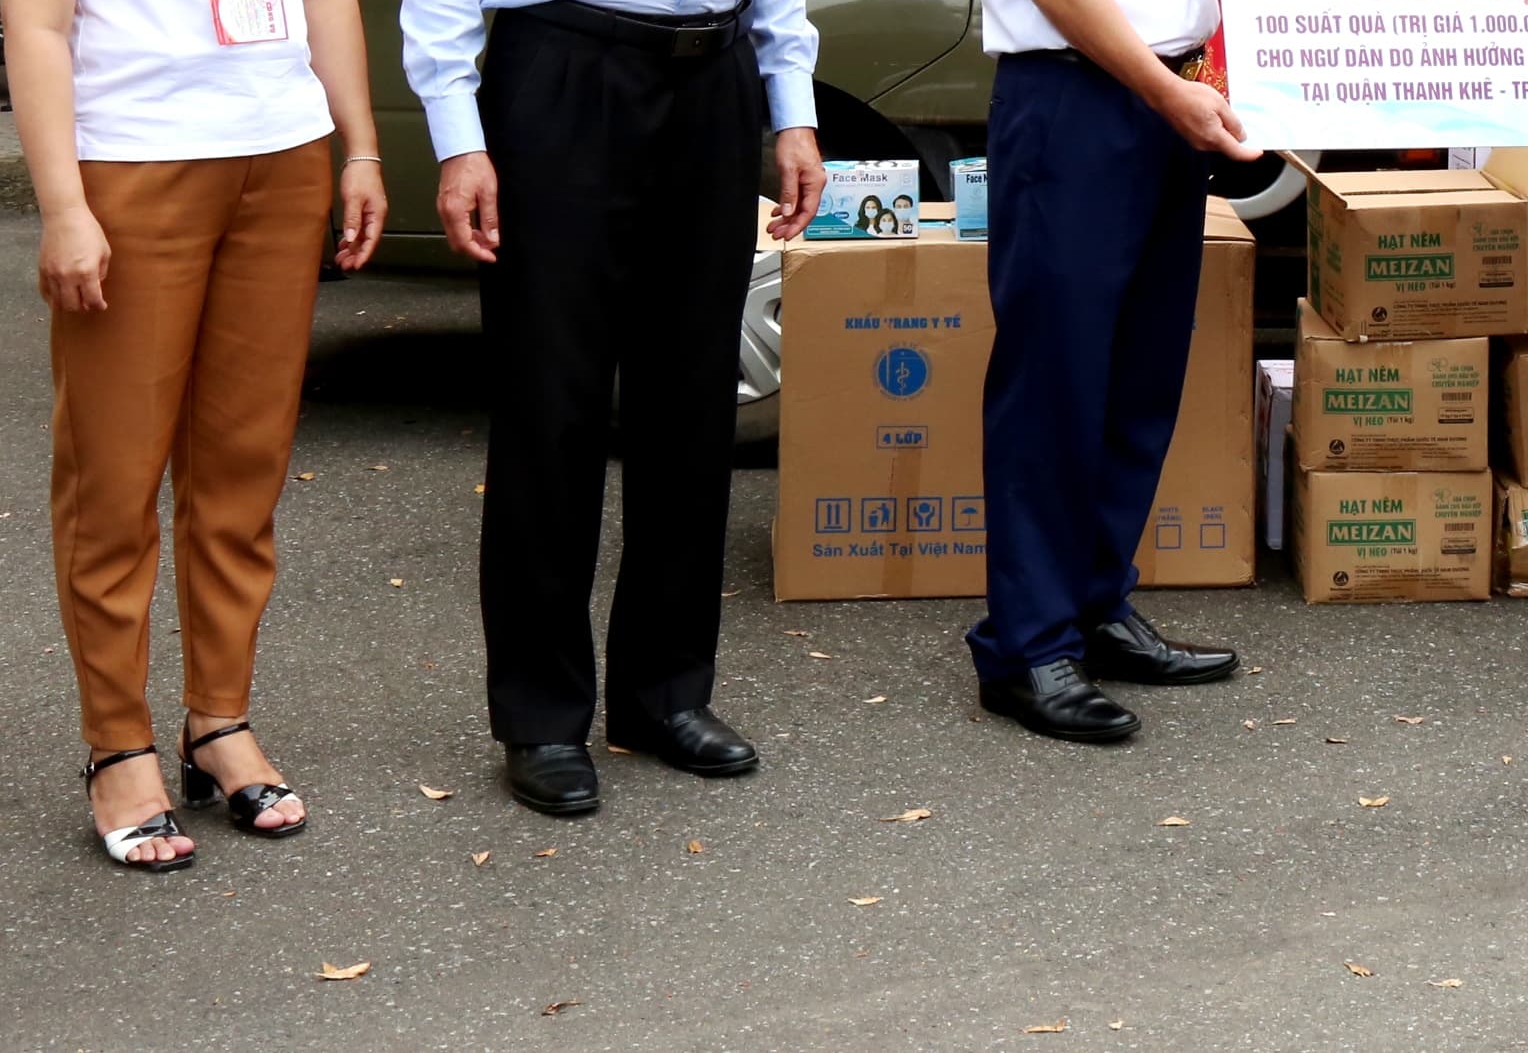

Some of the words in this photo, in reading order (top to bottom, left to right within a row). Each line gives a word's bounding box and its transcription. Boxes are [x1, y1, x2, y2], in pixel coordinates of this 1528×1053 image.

[1255, 15, 1289, 34] 100
[1295, 8, 1342, 34] SUẤT
[1349, 11, 1386, 36] QUÀ
[1393, 15, 1427, 38] (TRỊ
[1433, 11, 1464, 33] GIÁ
[1256, 49, 1294, 67] CHO
[1300, 47, 1340, 67] NGƯ
[1345, 44, 1383, 67] DÂN
[1389, 48, 1413, 67] DO
[1420, 42, 1457, 67] ẢNH
[1463, 42, 1524, 66] HƯỞNG
[1301, 82, 1330, 106] TẠI
[1336, 78, 1387, 106] QUẬN
[1392, 81, 1453, 101] THANH
[1459, 77, 1493, 100] KHÊ
[832, 173, 857, 182] Face
[860, 173, 888, 182] Mask
[966, 174, 982, 183] Face
[1378, 235, 1405, 250] HẠT
[1411, 231, 1441, 248] NÊM
[1370, 259, 1450, 276] MEIZAN
[1408, 282, 1426, 291] HEO
[931, 318, 940, 328] Y
[944, 314, 961, 328] TẾ
[1336, 368, 1362, 385] HẠT
[1369, 365, 1400, 382] NÊM
[1328, 394, 1408, 409] MEIZAN
[1353, 417, 1362, 428] VỊ
[1365, 417, 1384, 426] HEO
[883, 434, 891, 444] 4
[896, 430, 922, 444] LỚP
[1340, 500, 1367, 516] HẠT
[1372, 497, 1403, 513] NÊM
[1331, 525, 1412, 540] MEIZAN
[812, 543, 843, 557] Sản
[848, 540, 884, 556] Xuất
[889, 543, 913, 558] Tại
[918, 542, 948, 558] Việt
[953, 542, 987, 555] Nam
[1357, 547, 1366, 559] VỊ
[1369, 547, 1387, 556] HEO
